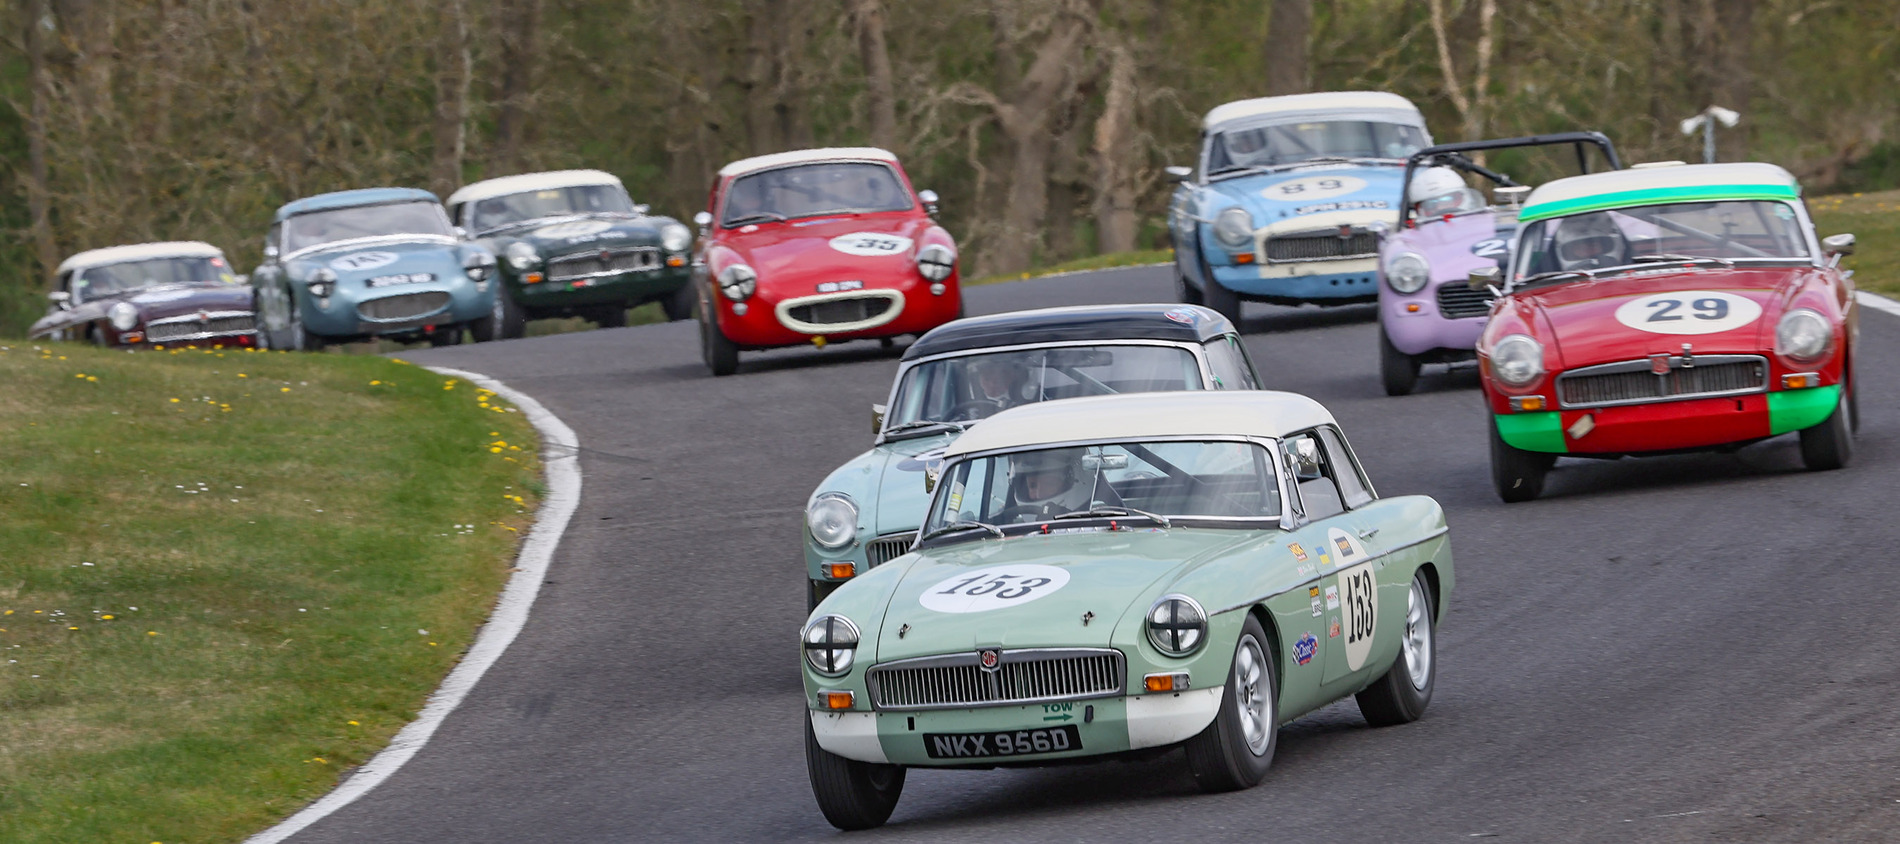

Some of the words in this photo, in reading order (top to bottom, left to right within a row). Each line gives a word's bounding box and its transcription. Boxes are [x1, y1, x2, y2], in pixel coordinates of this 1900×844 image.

[1280, 179, 1342, 194] 89
[855, 238, 899, 251] 35
[1645, 297, 1729, 323] 29
[936, 573, 1052, 600] 153
[1346, 569, 1374, 644] 153
[1042, 703, 1074, 713] TOW
[933, 734, 991, 758] NKX
[994, 728, 1070, 756] 956D
